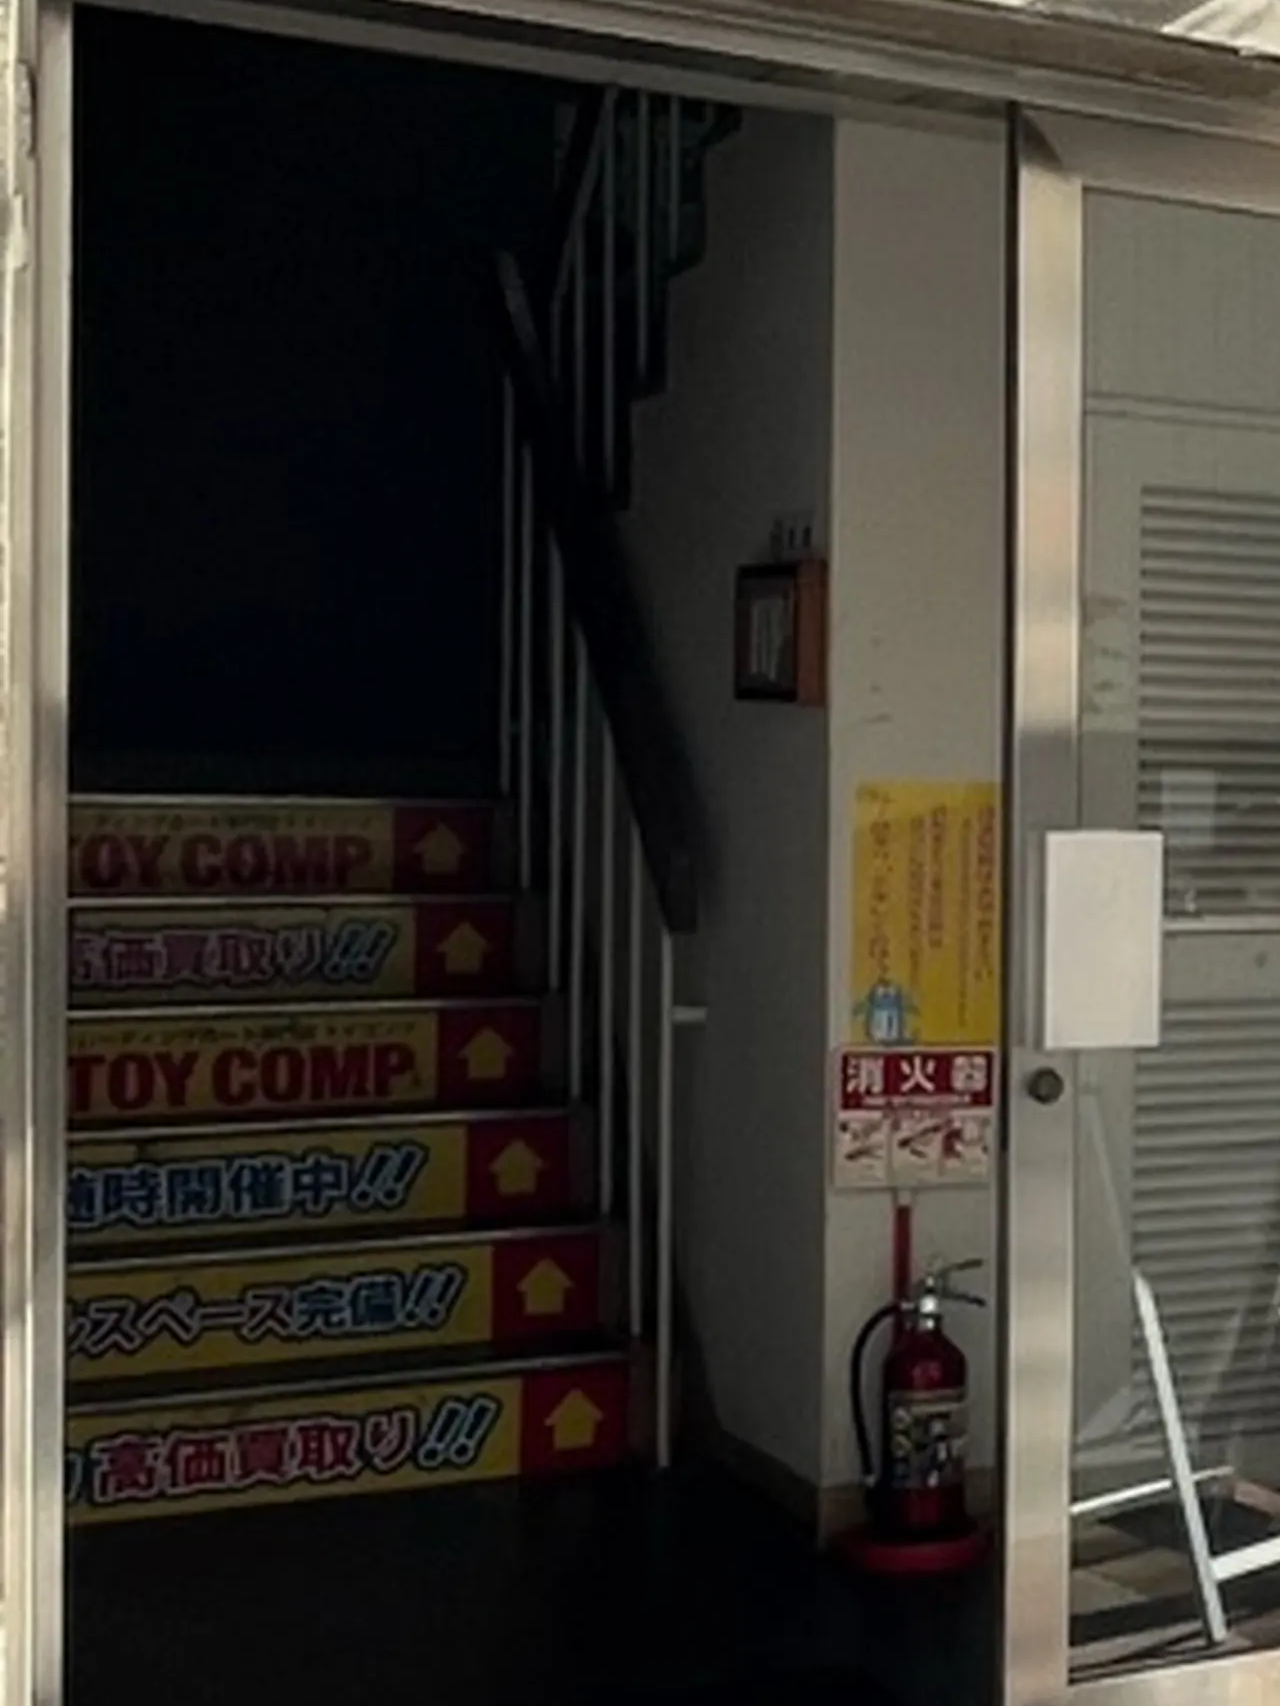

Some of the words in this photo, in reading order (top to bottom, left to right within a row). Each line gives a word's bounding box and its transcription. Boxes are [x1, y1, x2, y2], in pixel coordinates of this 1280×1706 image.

[179, 833, 371, 890] COMP
[212, 1042, 417, 1106] COMP
[846, 1054, 988, 1094] 消火器
